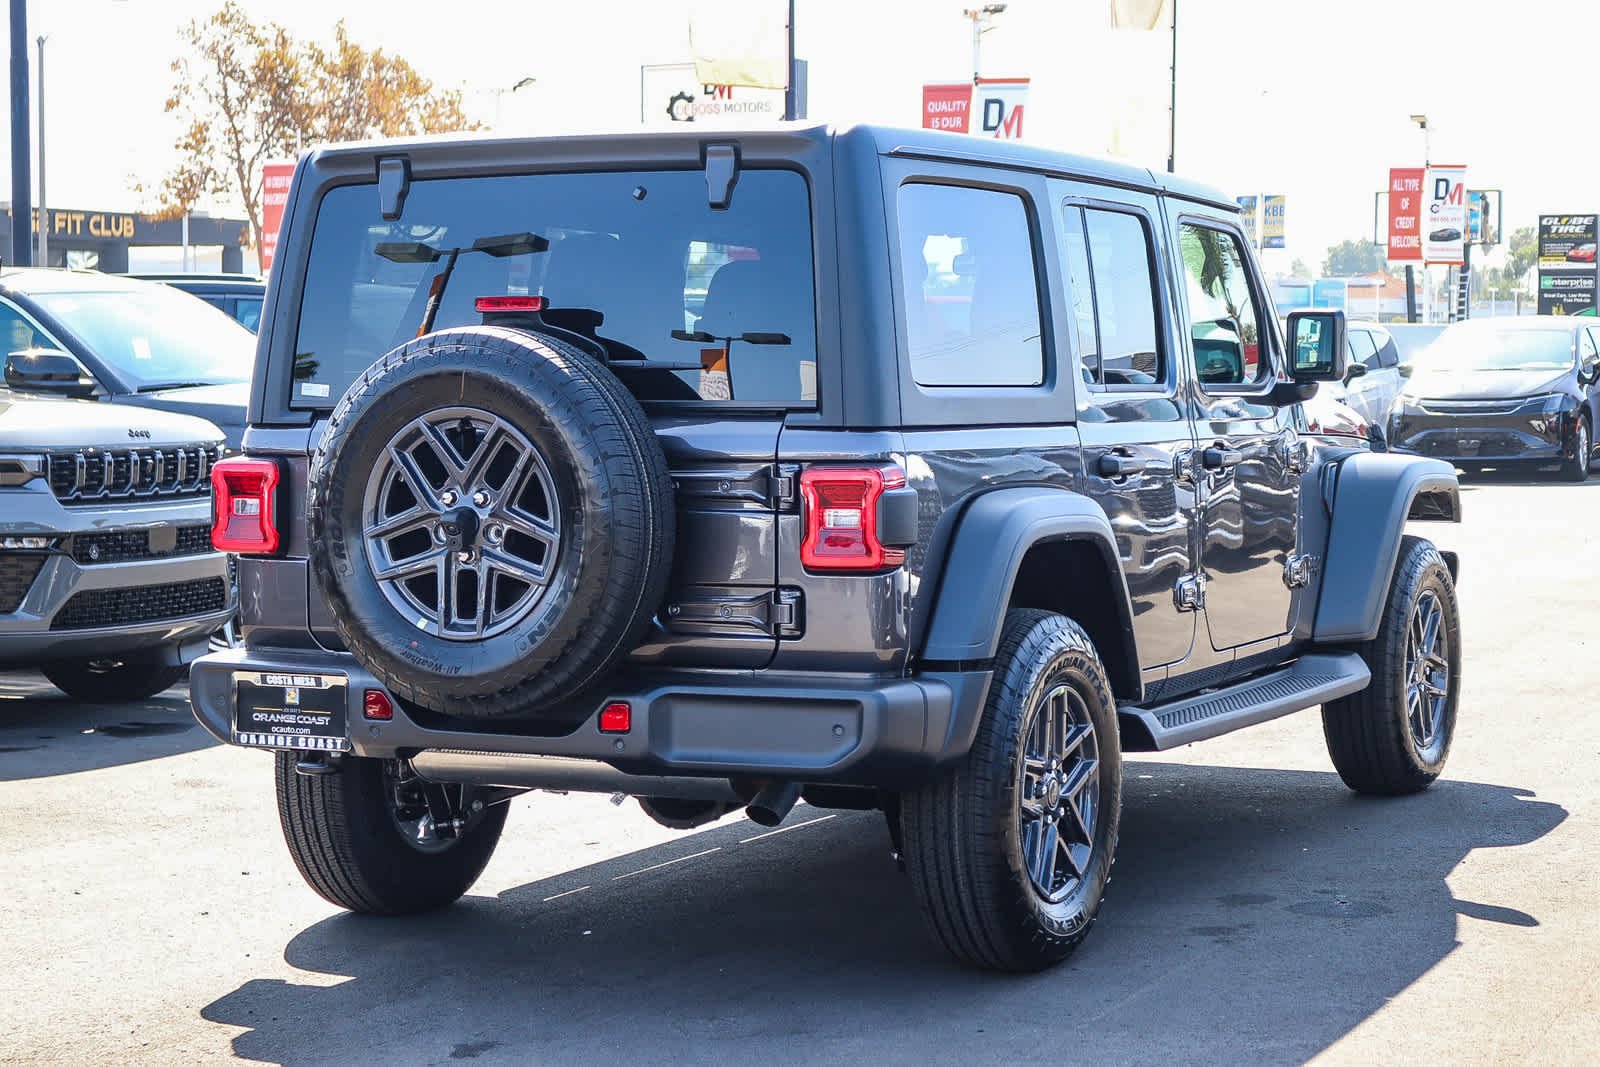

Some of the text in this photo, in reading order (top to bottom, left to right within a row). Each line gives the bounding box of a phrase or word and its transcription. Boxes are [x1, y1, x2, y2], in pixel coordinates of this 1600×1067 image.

[724, 101, 771, 113] MOTORS
[928, 100, 968, 113] QUALITY
[931, 117, 962, 128] IS OUR
[1393, 178, 1420, 191] ALL TYPE
[1401, 197, 1410, 209] OF
[1265, 206, 1285, 216] KBB
[55, 212, 85, 235] FIT
[90, 214, 135, 237] CLUB
[1395, 216, 1416, 229] CREDIT
[1551, 225, 1586, 233] TIRE
[1391, 235, 1420, 248] WELCOME
[1542, 278, 1593, 288] enterprise
[128, 428, 151, 439] Jeep
[400, 650, 463, 674] All-Weather
[266, 675, 317, 687] COSTA MESA
[252, 712, 331, 725] ORANGE COAST
[271, 726, 311, 735] ocauto.com
[240, 733, 343, 749] ORANGE COAST
